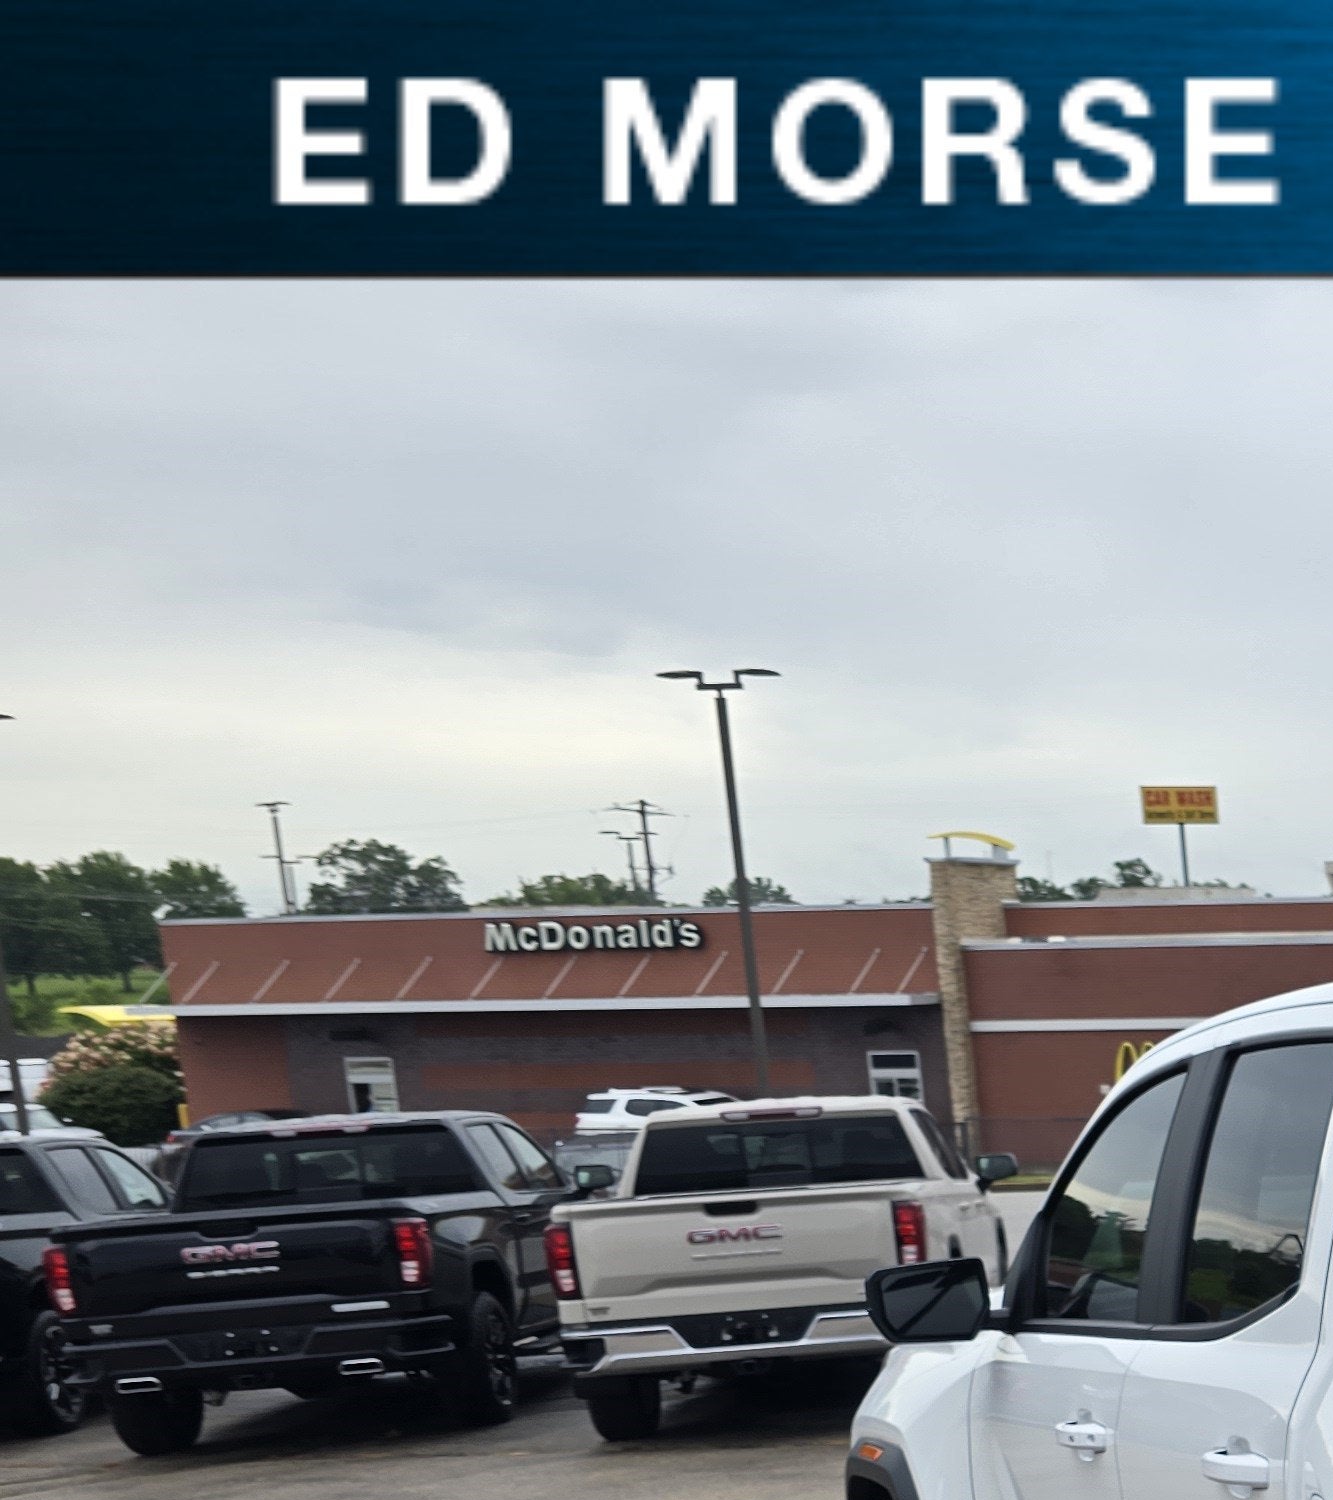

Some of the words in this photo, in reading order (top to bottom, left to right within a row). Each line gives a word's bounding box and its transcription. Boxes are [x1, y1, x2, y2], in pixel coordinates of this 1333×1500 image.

[484, 918, 702, 952] McDonald's
[687, 1223, 784, 1246] GMC
[181, 1241, 281, 1265] GMC
